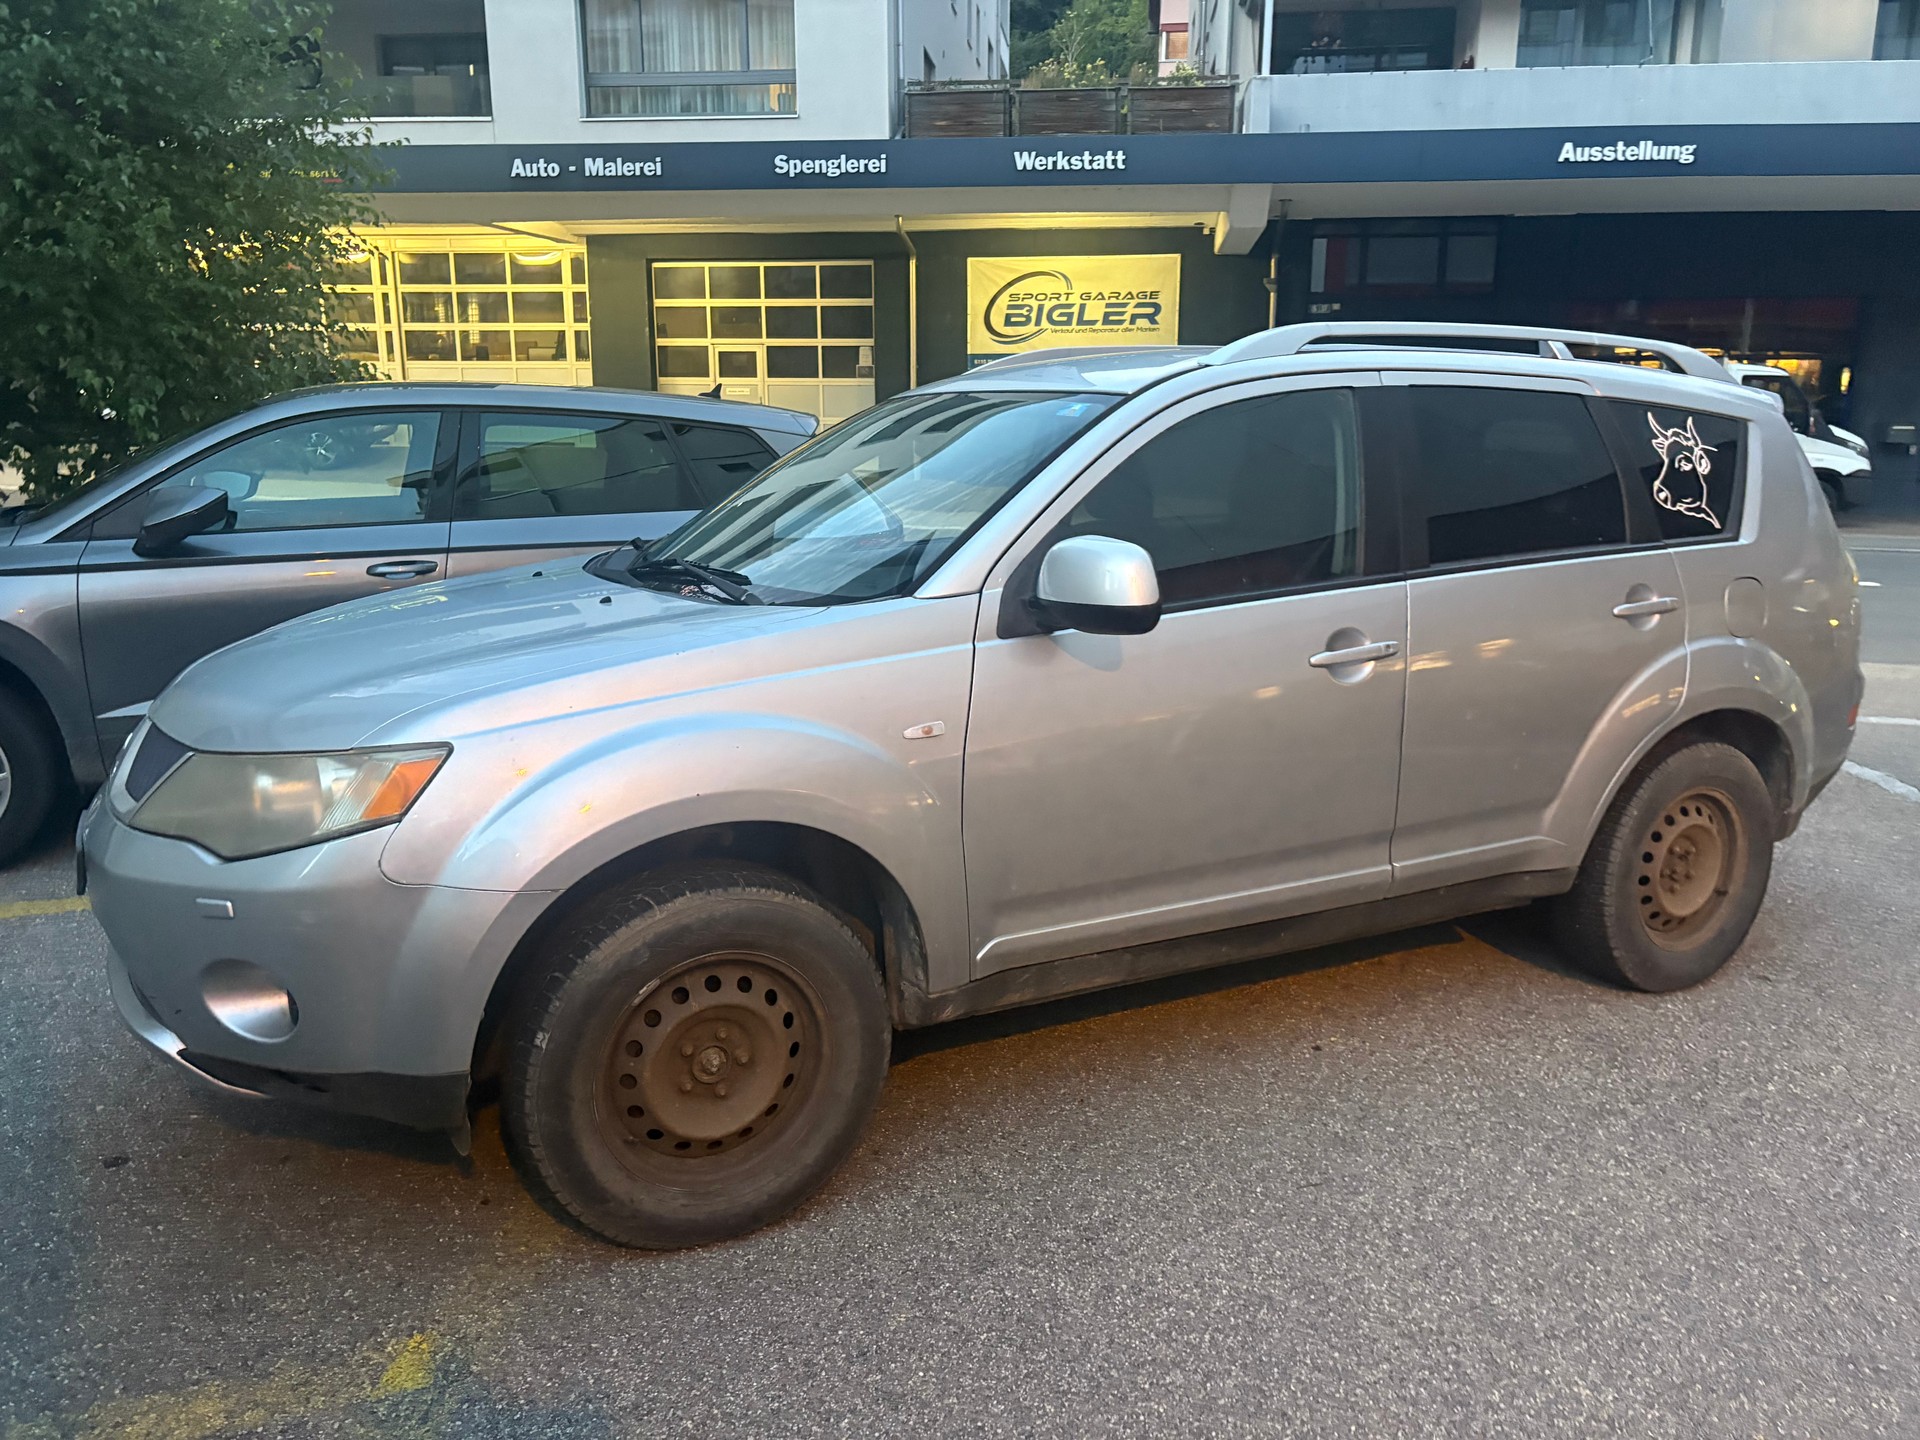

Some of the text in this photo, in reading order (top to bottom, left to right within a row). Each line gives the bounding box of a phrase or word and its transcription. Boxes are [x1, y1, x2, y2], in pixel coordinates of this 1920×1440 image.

[1013, 150, 1126, 171] Werkstatt
[1557, 140, 1697, 164] Ausstellung
[510, 158, 561, 178] Auto
[584, 157, 663, 177] Malerei
[774, 154, 888, 178] Spenglerei
[1008, 290, 1161, 302] SPORT GARAGE
[1003, 302, 1162, 328] BIGLER
